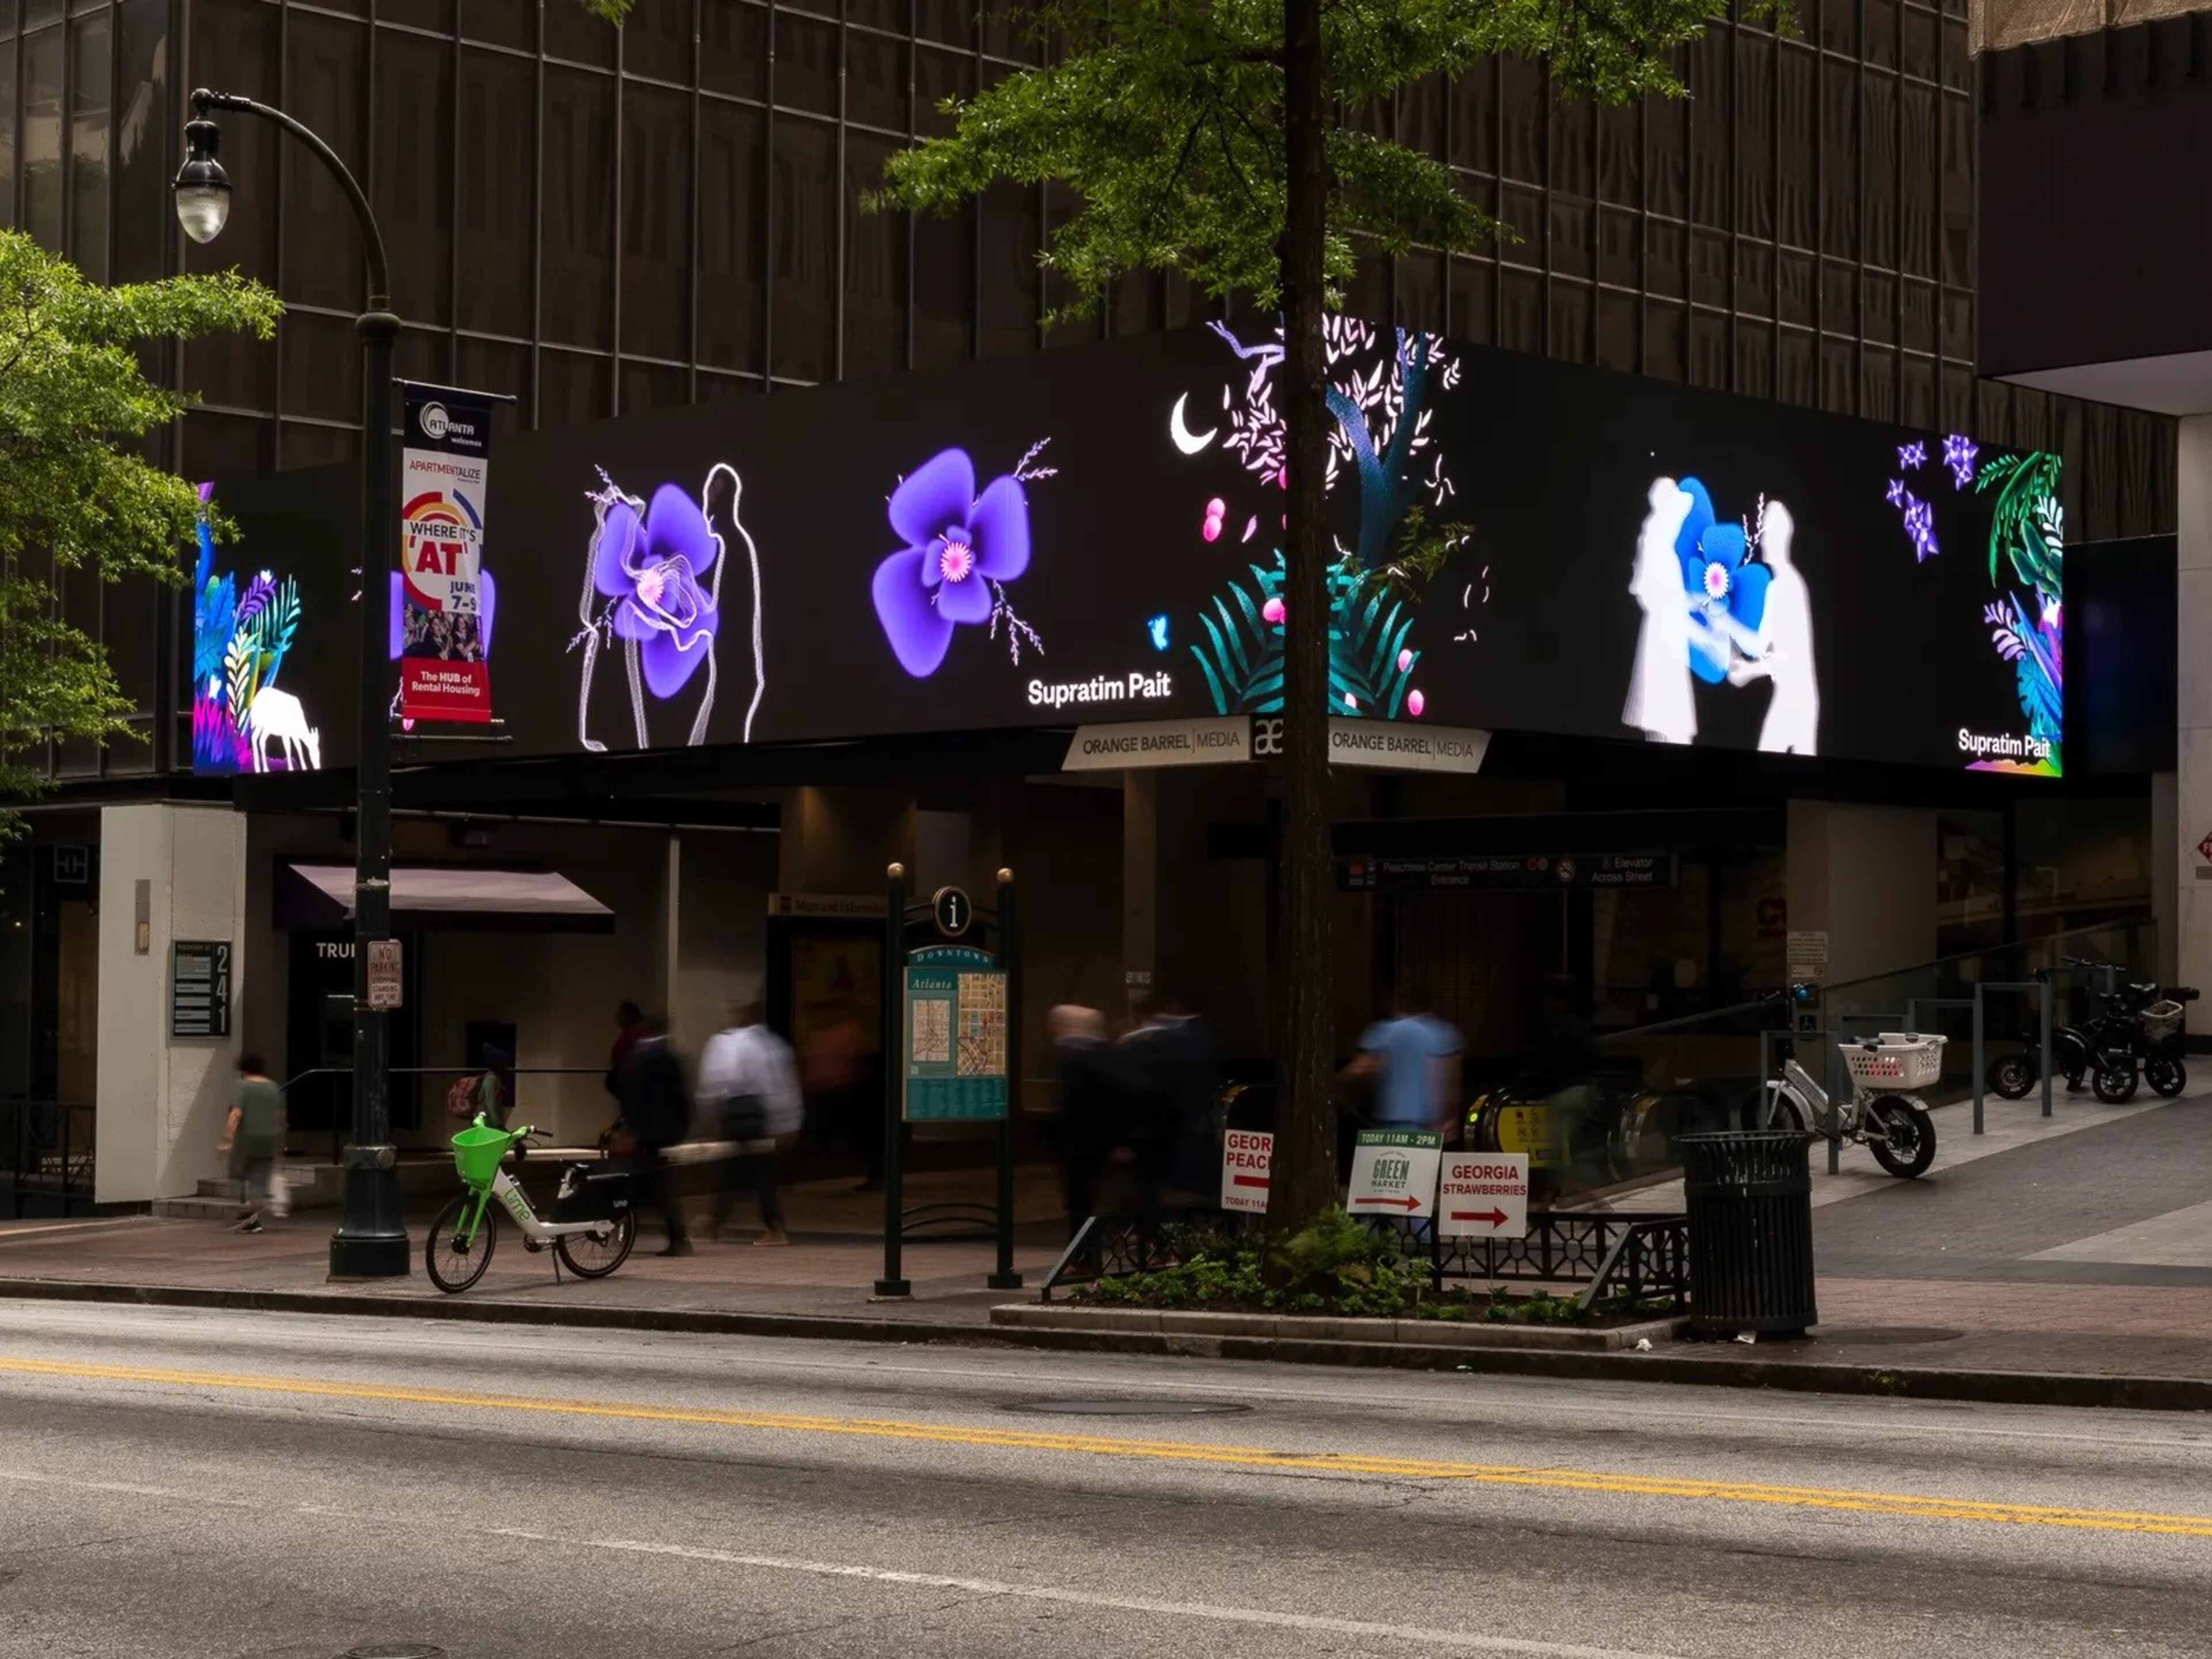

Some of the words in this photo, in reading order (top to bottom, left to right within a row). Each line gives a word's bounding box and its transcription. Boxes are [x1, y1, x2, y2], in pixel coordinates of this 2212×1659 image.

[430, 419, 475, 435] ATLANTA
[450, 437, 482, 447] welcomes
[409, 460, 481, 479] APARTMENTALIZE
[410, 522, 457, 538] WHERE
[460, 528, 476, 542] IT'S
[421, 671, 437, 681] The
[439, 672, 460, 683] HUB
[461, 674, 472, 683] of
[412, 681, 441, 692] Rental
[442, 683, 480, 697] Housing
[1028, 675, 1124, 709] Supratim
[1128, 671, 1171, 698] Pait
[1083, 737, 1138, 755] ORANGE
[1141, 734, 1190, 752] BARREL
[1196, 732, 1240, 747] MEDIA
[1332, 732, 1384, 750] ORANGE
[1387, 737, 1431, 754] BARREL
[1437, 742, 1474, 757] MEDIA
[1959, 728, 2022, 757] Supratim
[2024, 735, 2051, 758] Pait
[1427, 861, 1456, 871] Center
[1459, 860, 1488, 871] Transit
[1489, 859, 1520, 870] Station
[1614, 857, 1653, 868] Elevator
[1591, 872, 1623, 882] Across
[1624, 871, 1653, 882] Street
[380, 947, 392, 960] NO
[917, 949, 989, 963] DOWNTOWN
[370, 963, 399, 974] PARKING
[912, 978, 952, 990] Atlanta
[1362, 1133, 1384, 1143] TODAY
[1386, 1134, 1409, 1144] 11AM
[1416, 1135, 1436, 1145] 2PM
[1372, 1159, 1410, 1180] GREEN
[1452, 1165, 1519, 1179] GEORGIA
[1371, 1180, 1406, 1188] MARKET
[1442, 1184, 1527, 1195] STRAWBERRIES
[504, 1187, 531, 1222] Lime
[1225, 1197, 1249, 1206] TODAY
[1251, 1200, 1267, 1209] 11A
